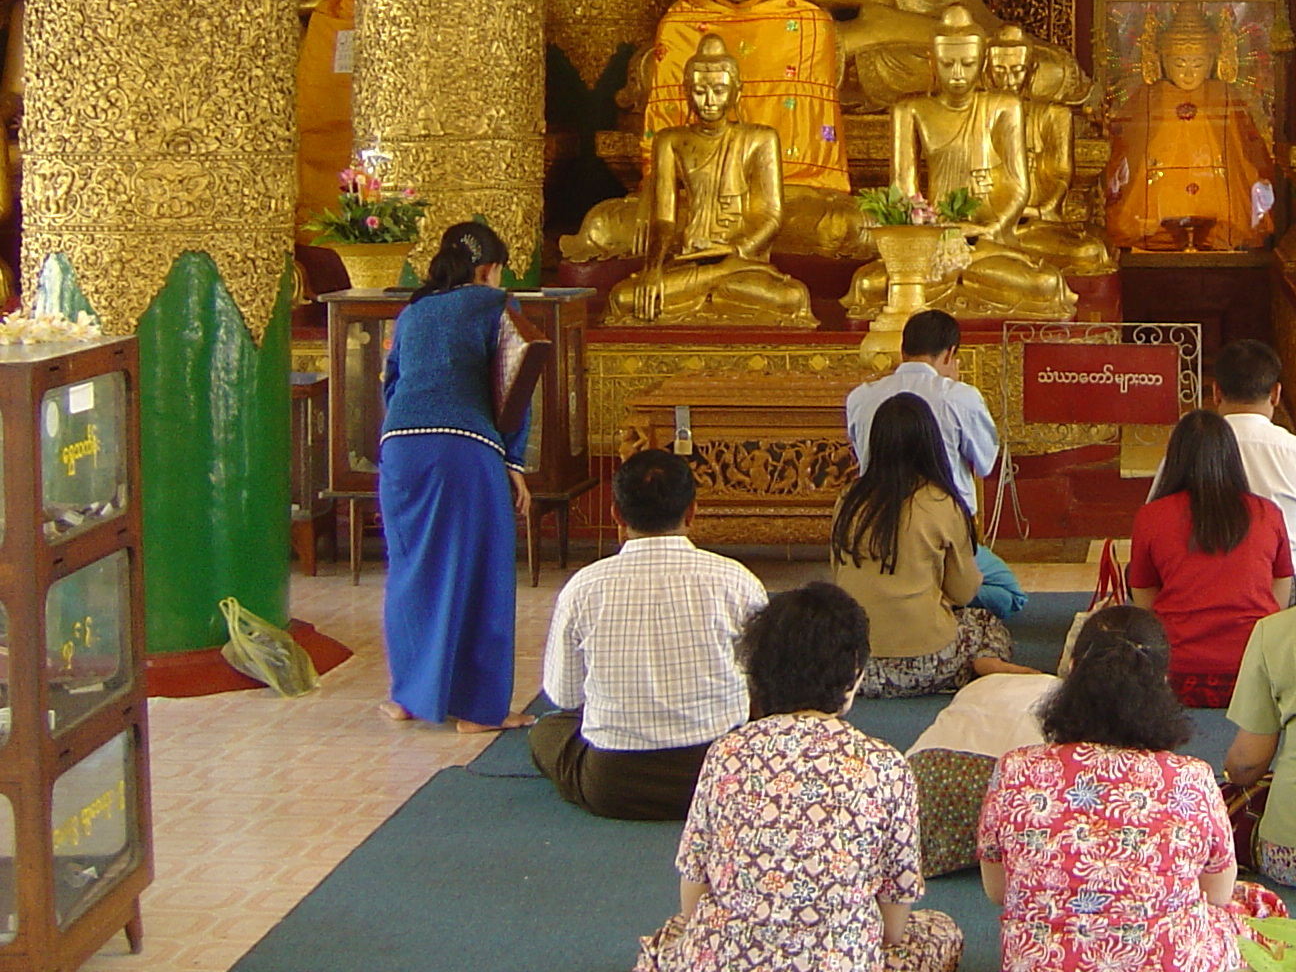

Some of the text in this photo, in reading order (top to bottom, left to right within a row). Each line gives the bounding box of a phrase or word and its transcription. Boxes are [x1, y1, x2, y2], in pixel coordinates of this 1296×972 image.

[1037, 364, 1163, 393] သံဃာတော်များသာ
